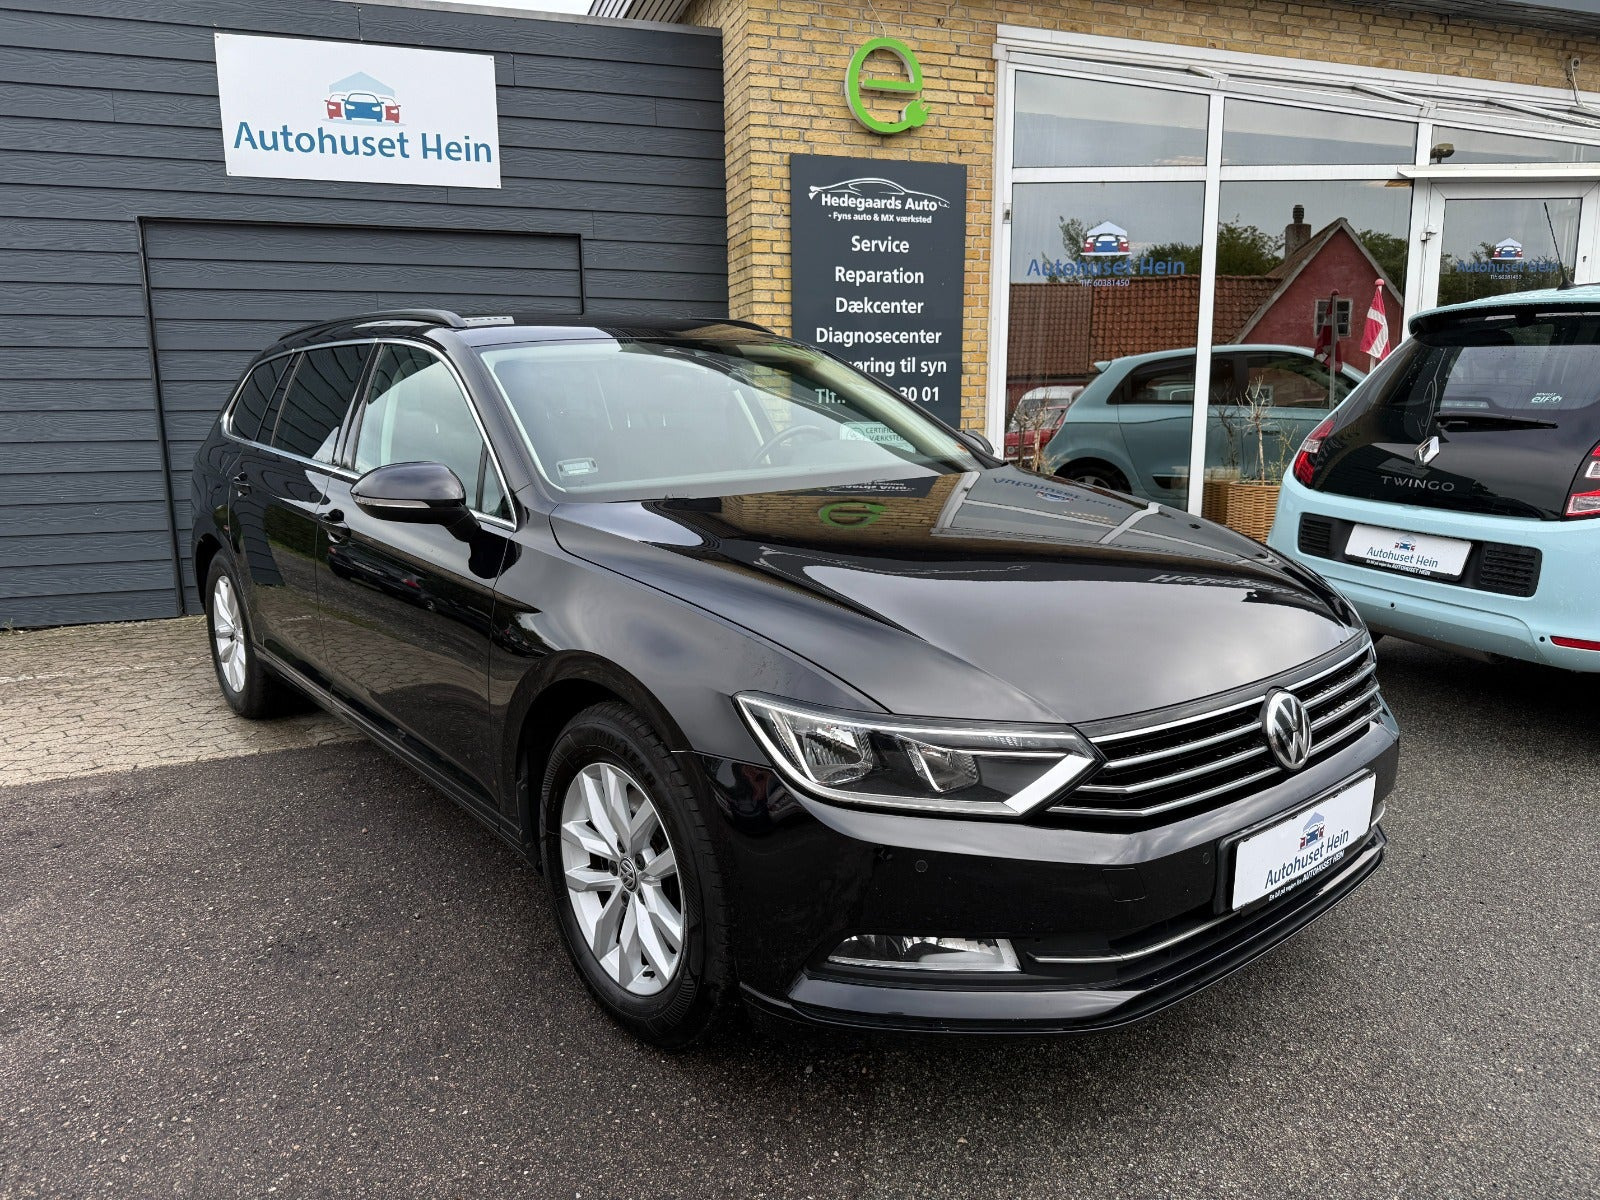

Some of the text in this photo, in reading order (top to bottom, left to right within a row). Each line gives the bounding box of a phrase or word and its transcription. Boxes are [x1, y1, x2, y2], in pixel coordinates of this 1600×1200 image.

[233, 121, 492, 163] Autohuset Hein
[821, 193, 938, 211] Hedegaards Auto
[833, 211, 852, 221] Fyns
[853, 214, 872, 222] auto
[873, 213, 880, 222] &
[881, 214, 895, 222] MX
[896, 215, 933, 224] værksted
[851, 235, 910, 253] Service
[1027, 256, 1186, 277] Autohuset Hein
[1456, 260, 1558, 273] Autohuset Hein
[835, 266, 924, 287] Reparation
[1093, 279, 1130, 287] 60381450
[836, 297, 924, 314] Dækcenter
[816, 327, 942, 347] Diagnosecenter
[848, 356, 947, 377] øring til syn
[921, 386, 940, 402] 01
[1380, 475, 1455, 492] TWINGO
[1366, 546, 1414, 564] Autohuset
[1416, 554, 1438, 569] Hein
[1264, 829, 1349, 889] Autohuset Hein
